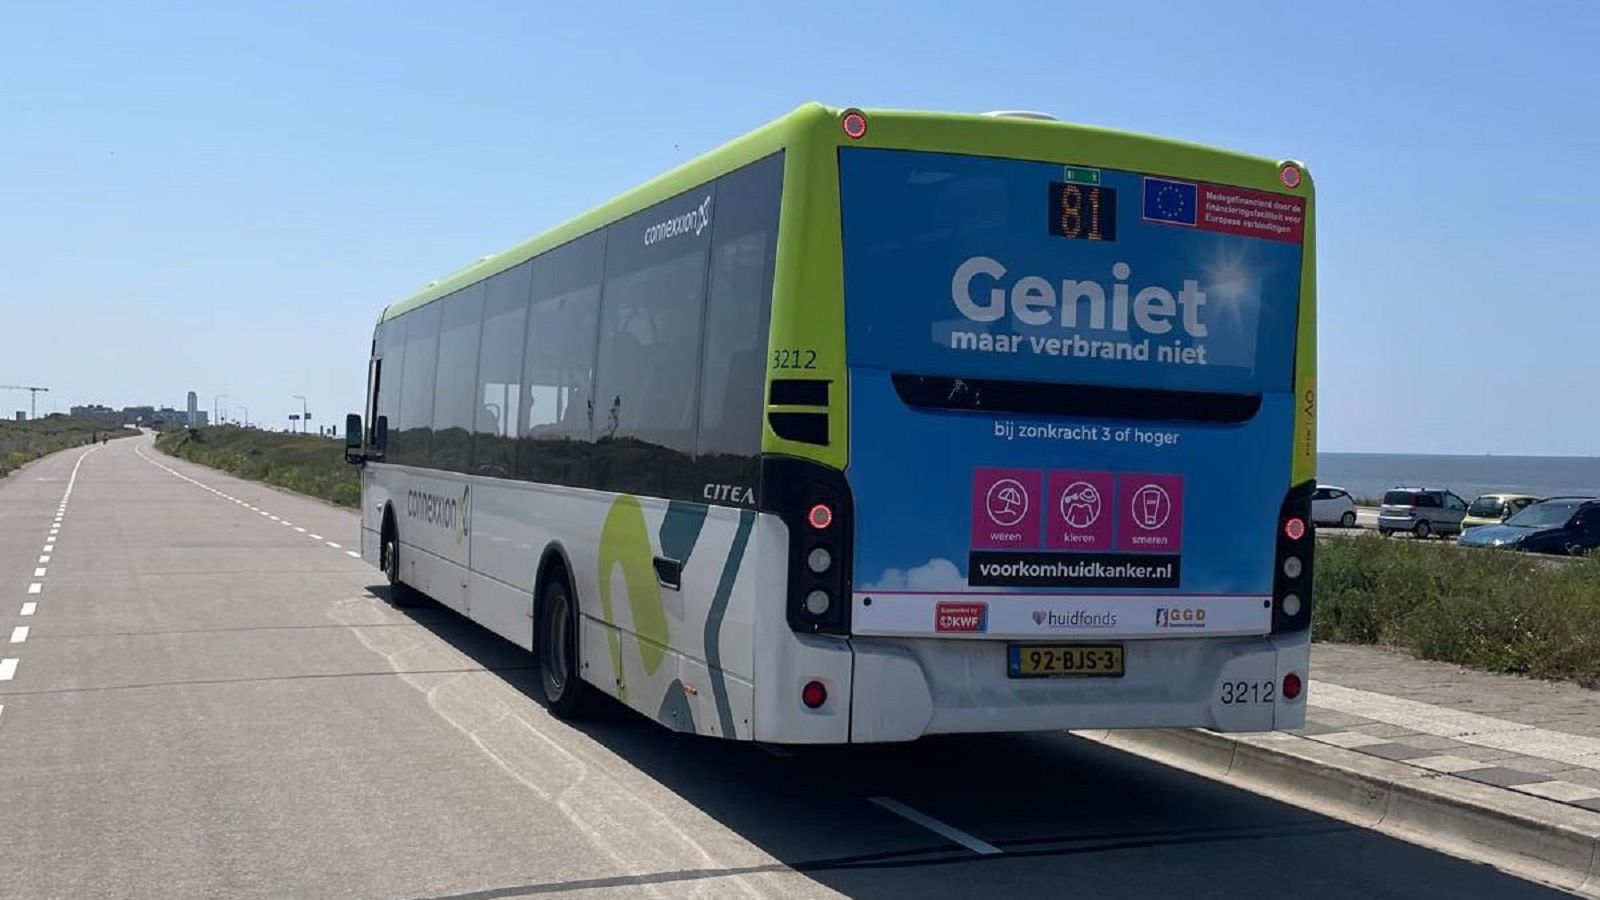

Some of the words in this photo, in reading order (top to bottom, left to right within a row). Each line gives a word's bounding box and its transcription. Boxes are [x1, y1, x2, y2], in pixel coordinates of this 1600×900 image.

[1061, 184, 1103, 241] 81
[1273, 202, 1291, 211] door
[1292, 205, 1302, 213] de
[644, 210, 697, 245] connexxion
[1205, 213, 1241, 226] Europese
[1242, 221, 1292, 234] verbindingen
[1284, 214, 1302, 224] voor
[951, 256, 1209, 336] Geniet
[950, 330, 1023, 353] maar
[1030, 335, 1150, 362] verbrand
[1157, 339, 1208, 365] niet
[772, 349, 818, 370] 3212
[994, 421, 1015, 441] bij
[1018, 425, 1098, 441] zonkracht
[1101, 427, 1111, 441] 3
[1115, 428, 1131, 442] of
[1134, 429, 1180, 446] hoger
[703, 483, 756, 504] CITEA
[408, 490, 456, 530] connexxion
[990, 532, 1022, 541] weren
[1064, 531, 1095, 542] kleren
[1132, 536, 1168, 545] smeren
[979, 560, 1173, 579] voorkomhuidkanker.nl
[952, 616, 979, 627] KWF
[1048, 608, 1117, 626] huidfonds
[1170, 609, 1206, 621] GGD
[1030, 651, 1115, 671] 92-BJS-3
[1221, 680, 1275, 704] 3212
